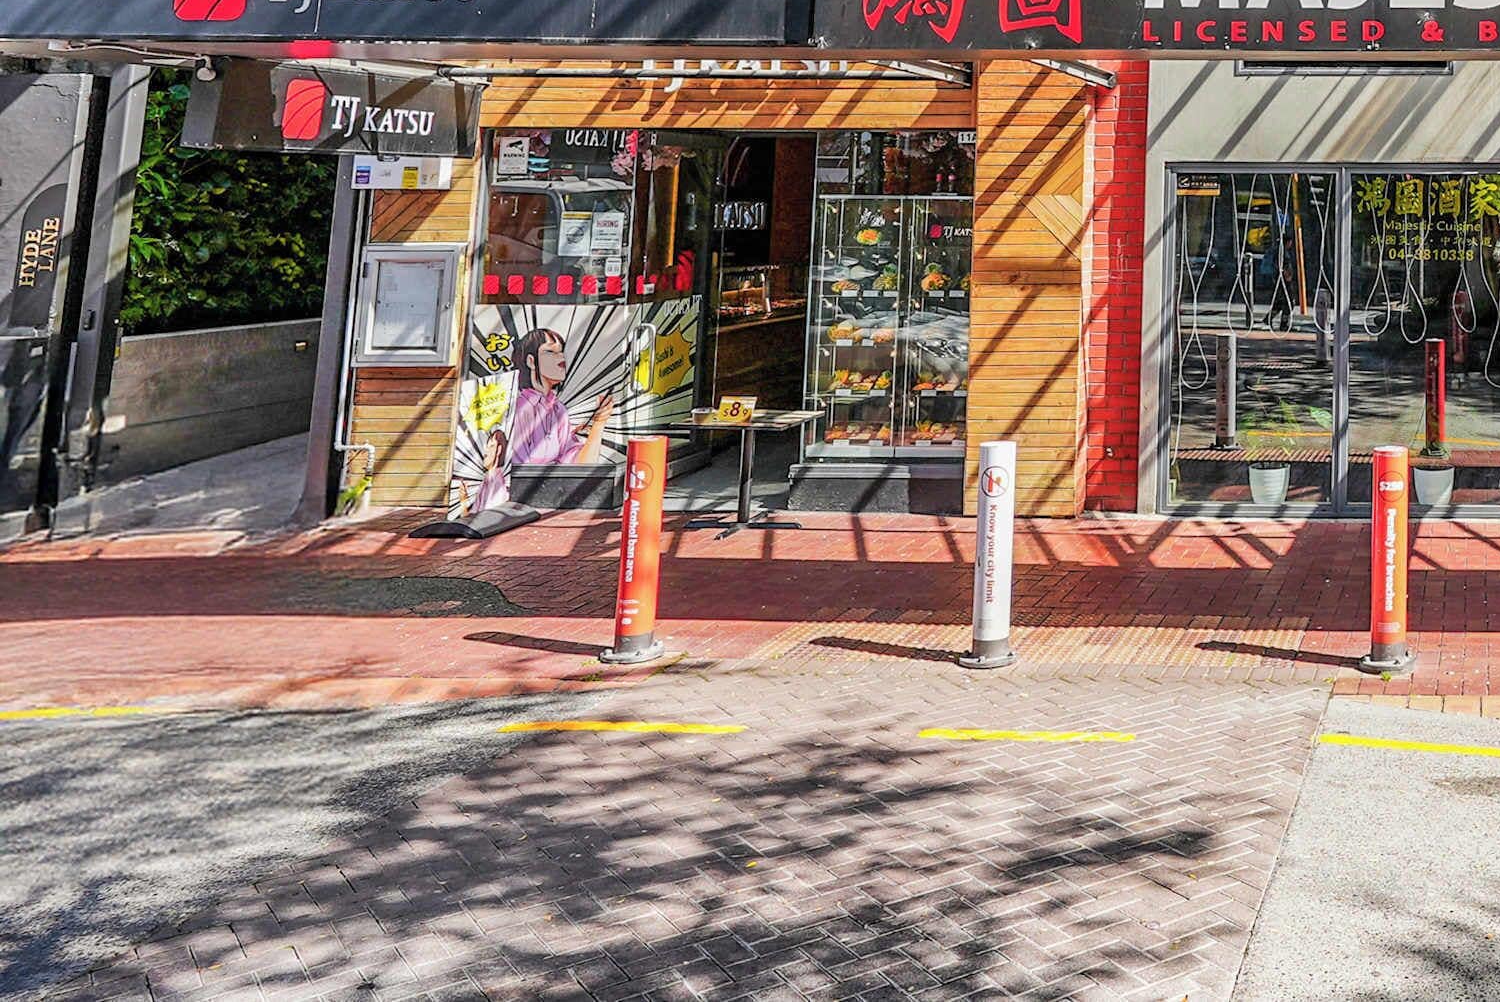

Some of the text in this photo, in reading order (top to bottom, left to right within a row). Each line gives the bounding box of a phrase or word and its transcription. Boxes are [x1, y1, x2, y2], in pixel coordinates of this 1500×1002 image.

[1142, 19, 1386, 43] LICENSED
[1421, 19, 1445, 43] &
[330, 96, 435, 139] TJ KATSU
[19, 229, 42, 287] HYDE
[38, 217, 61, 272] LANE
[624, 499, 641, 583] Alcohol ban area
[1384, 508, 1398, 548] Penalty
[984, 504, 998, 604] Know your city limit
[1385, 548, 1397, 565] for
[1384, 565, 1396, 612] breaches
